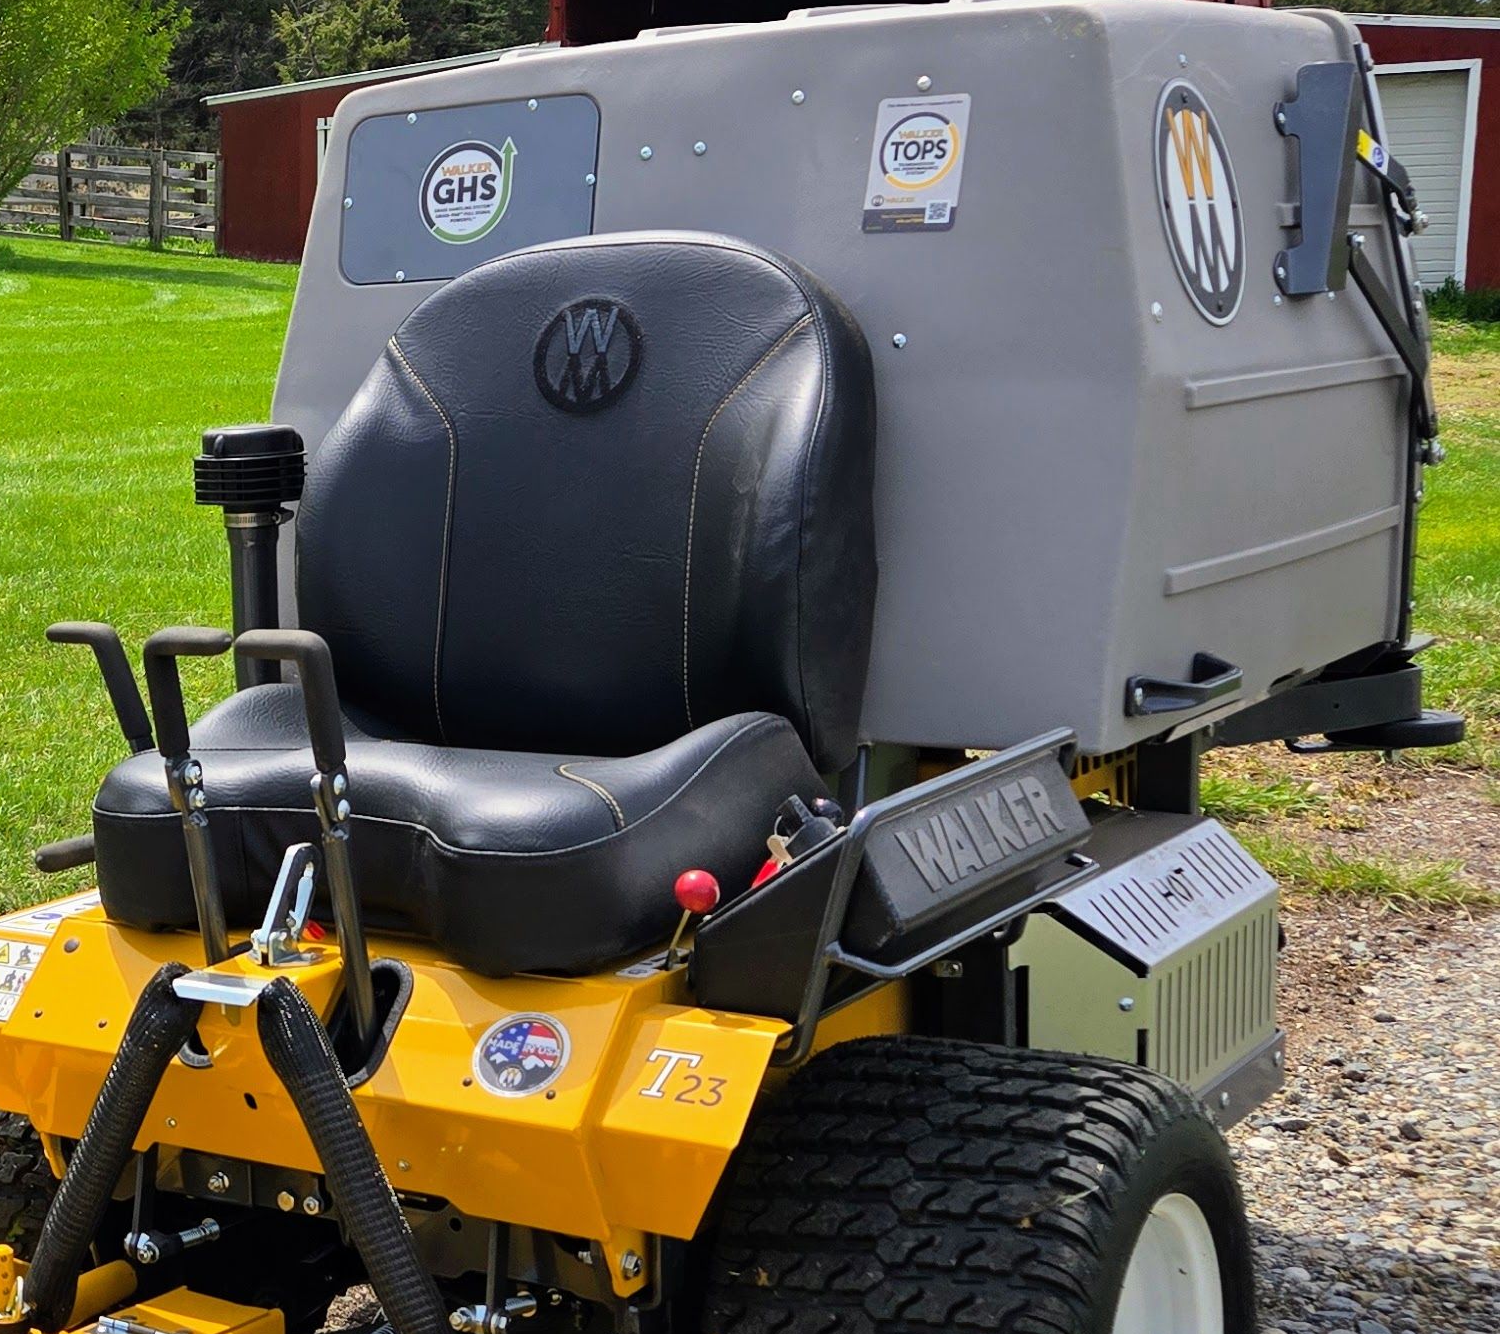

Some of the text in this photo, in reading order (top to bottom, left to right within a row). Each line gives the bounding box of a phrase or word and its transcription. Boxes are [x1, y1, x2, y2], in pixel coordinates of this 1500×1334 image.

[890, 139, 948, 162] TOPS
[441, 162, 492, 177] WALKER
[433, 173, 497, 205] GHS
[894, 776, 1066, 893] WALKER
[1151, 867, 1204, 913] HOT
[486, 1037, 521, 1051] MADE
